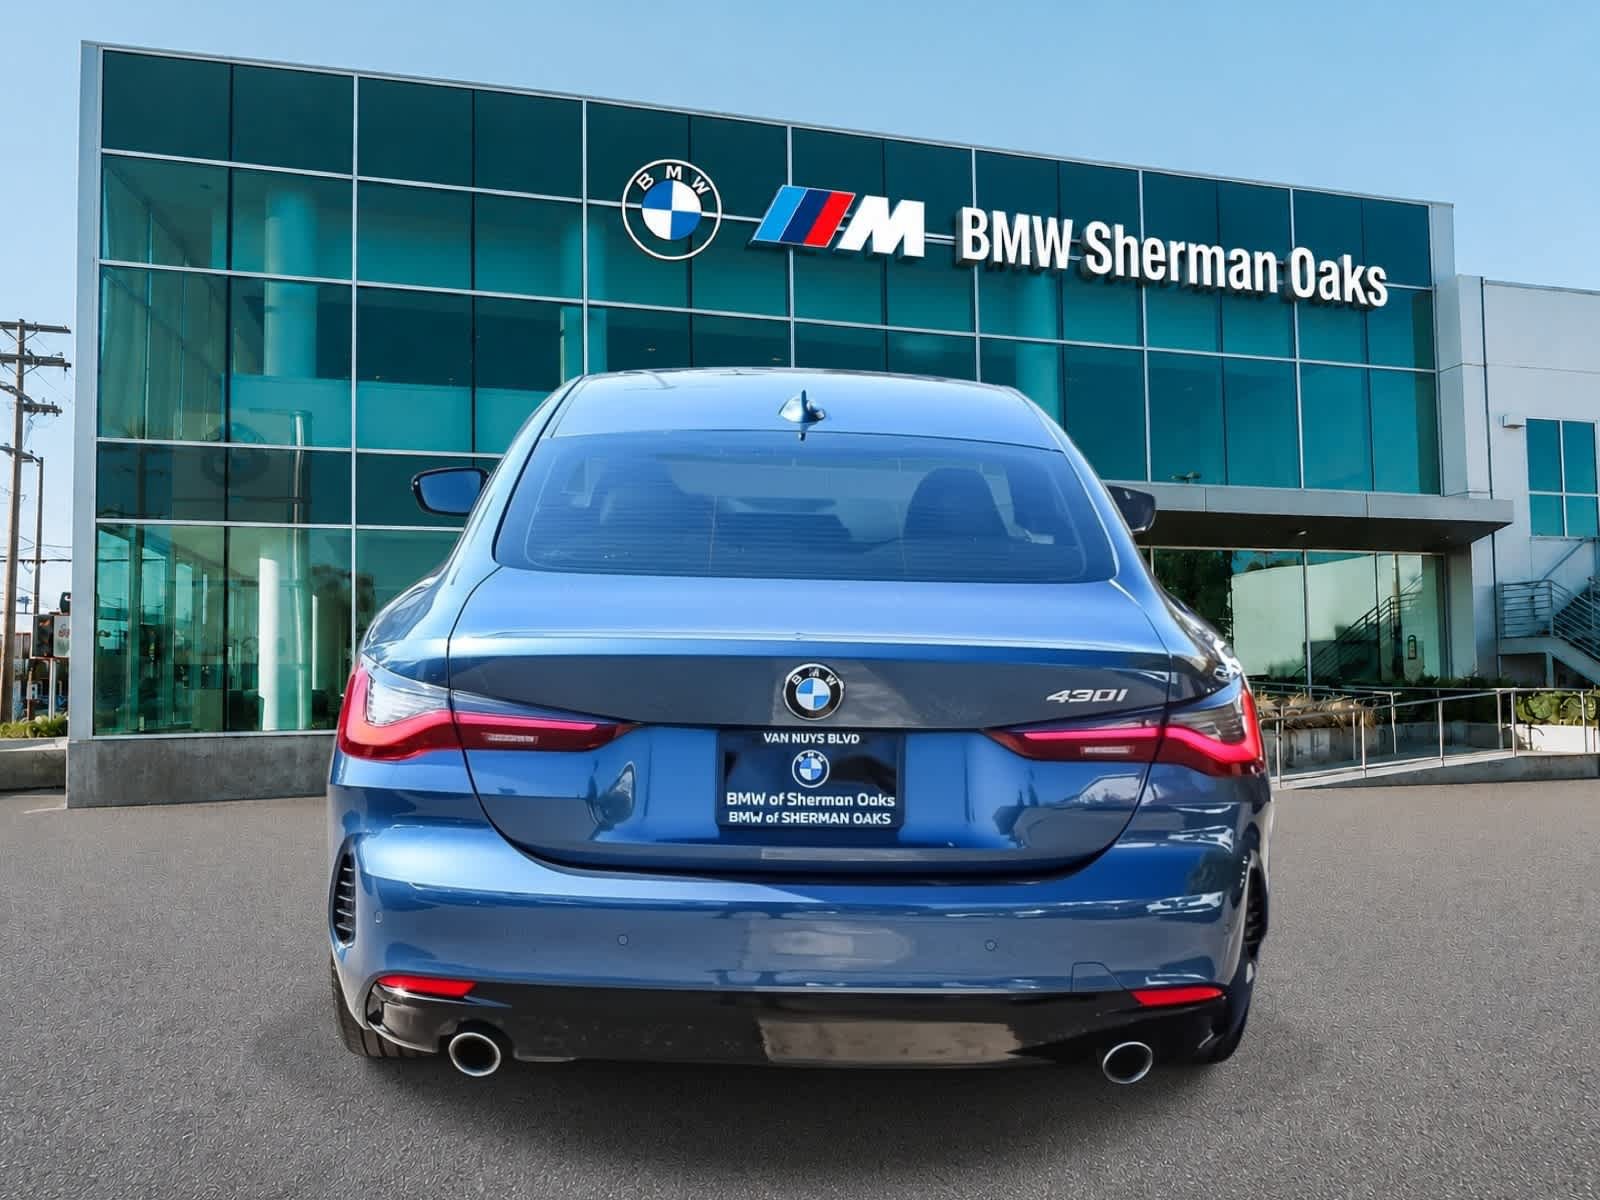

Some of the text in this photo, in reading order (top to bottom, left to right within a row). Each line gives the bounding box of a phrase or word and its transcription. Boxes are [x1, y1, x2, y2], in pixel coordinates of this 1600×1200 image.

[636, 165, 711, 193] BMW
[961, 207, 1388, 307] BMW Sherman Oaks
[791, 668, 837, 687] BMW
[763, 733, 860, 744] VAN NUYS BLVD
[726, 792, 895, 806] BMW of Sherman Oaks
[728, 811, 891, 824] BMW of SHERMAN OAKS
